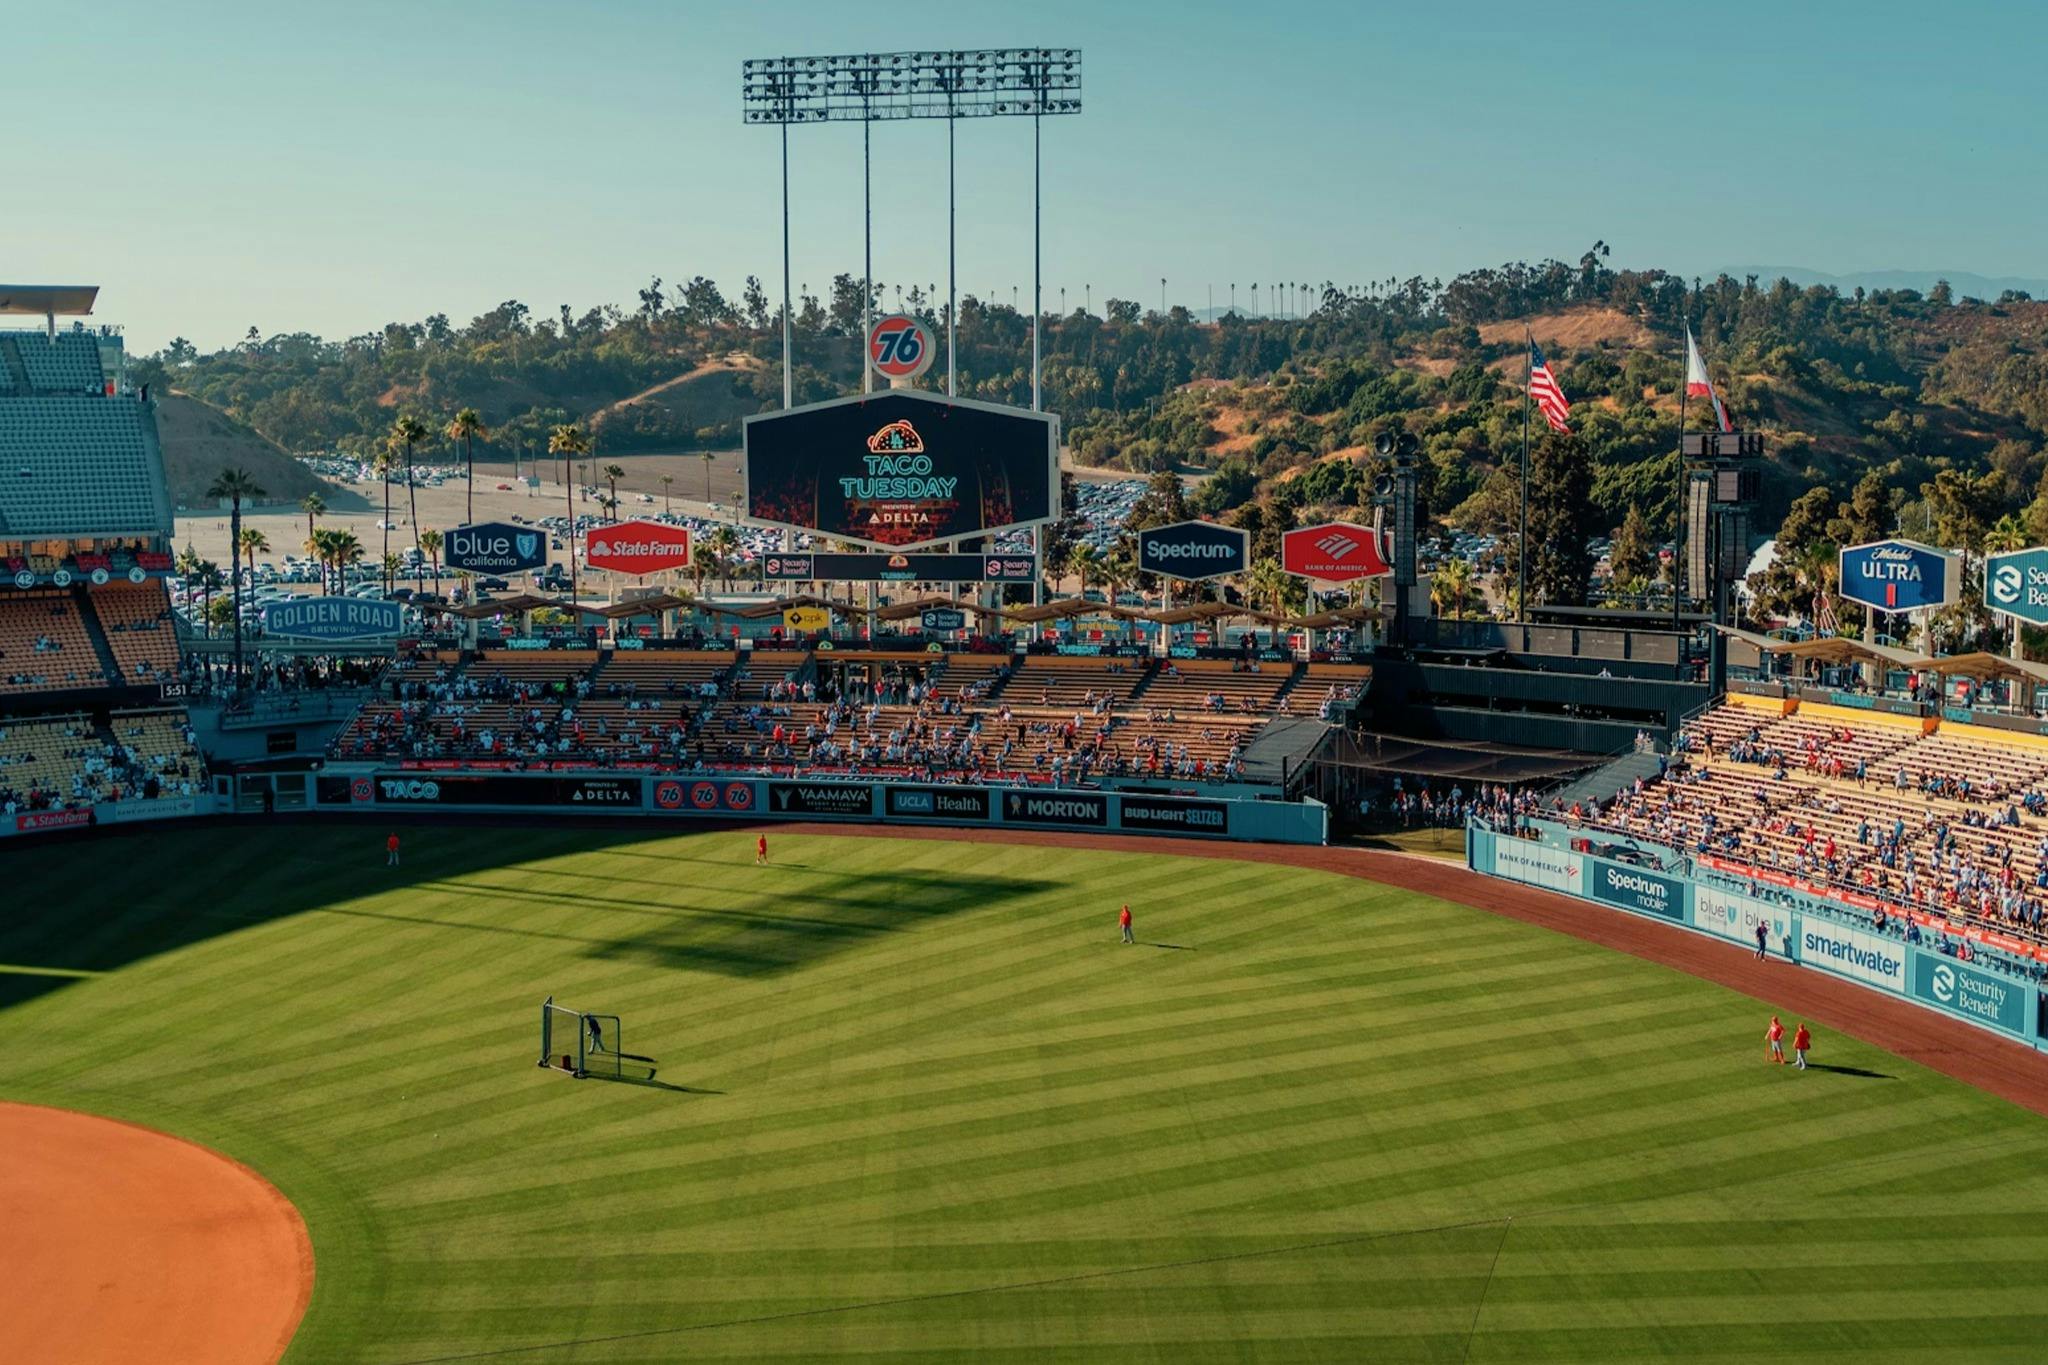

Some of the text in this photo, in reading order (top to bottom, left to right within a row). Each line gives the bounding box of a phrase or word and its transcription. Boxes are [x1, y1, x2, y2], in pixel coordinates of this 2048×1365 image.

[874, 327, 922, 364] 76
[863, 455, 932, 475] TACO
[839, 477, 957, 498] TUESDAY
[883, 512, 929, 522] DELTA
[453, 533, 510, 554] blue
[1147, 540, 1229, 561] Spectrum
[462, 556, 517, 566] california
[18, 574, 32, 584] 42
[1862, 561, 1922, 581] ULTRA
[2028, 566, 2048, 585] Se
[2028, 588, 2048, 606] Be
[273, 603, 394, 629] GOLDEN ROAD
[311, 626, 356, 634] BREWING
[617, 640, 644, 650] TACO
[1170, 647, 1197, 658] TACO
[165, 684, 187, 696] 5:51
[354, 783, 368, 795] 76
[380, 780, 439, 799] TACO
[587, 790, 630, 800] DELTA
[660, 788, 679, 802] 76
[695, 788, 713, 803] 76
[730, 788, 748, 803] 76
[899, 796, 981, 812] UCLA Health
[1027, 799, 1098, 818] MORTON
[1124, 808, 1224, 826] BUD LIGHT SELTZER
[1500, 852, 1518, 864] BANK
[1531, 860, 1563, 874] AMERICA
[1607, 868, 1665, 897] Spectrum
[1636, 893, 1666, 910] mobile
[1700, 896, 1725, 918] blue
[1806, 932, 1900, 978] smartwater
[1958, 972, 2006, 1003] Security
[1960, 992, 2000, 1020] Benefit
